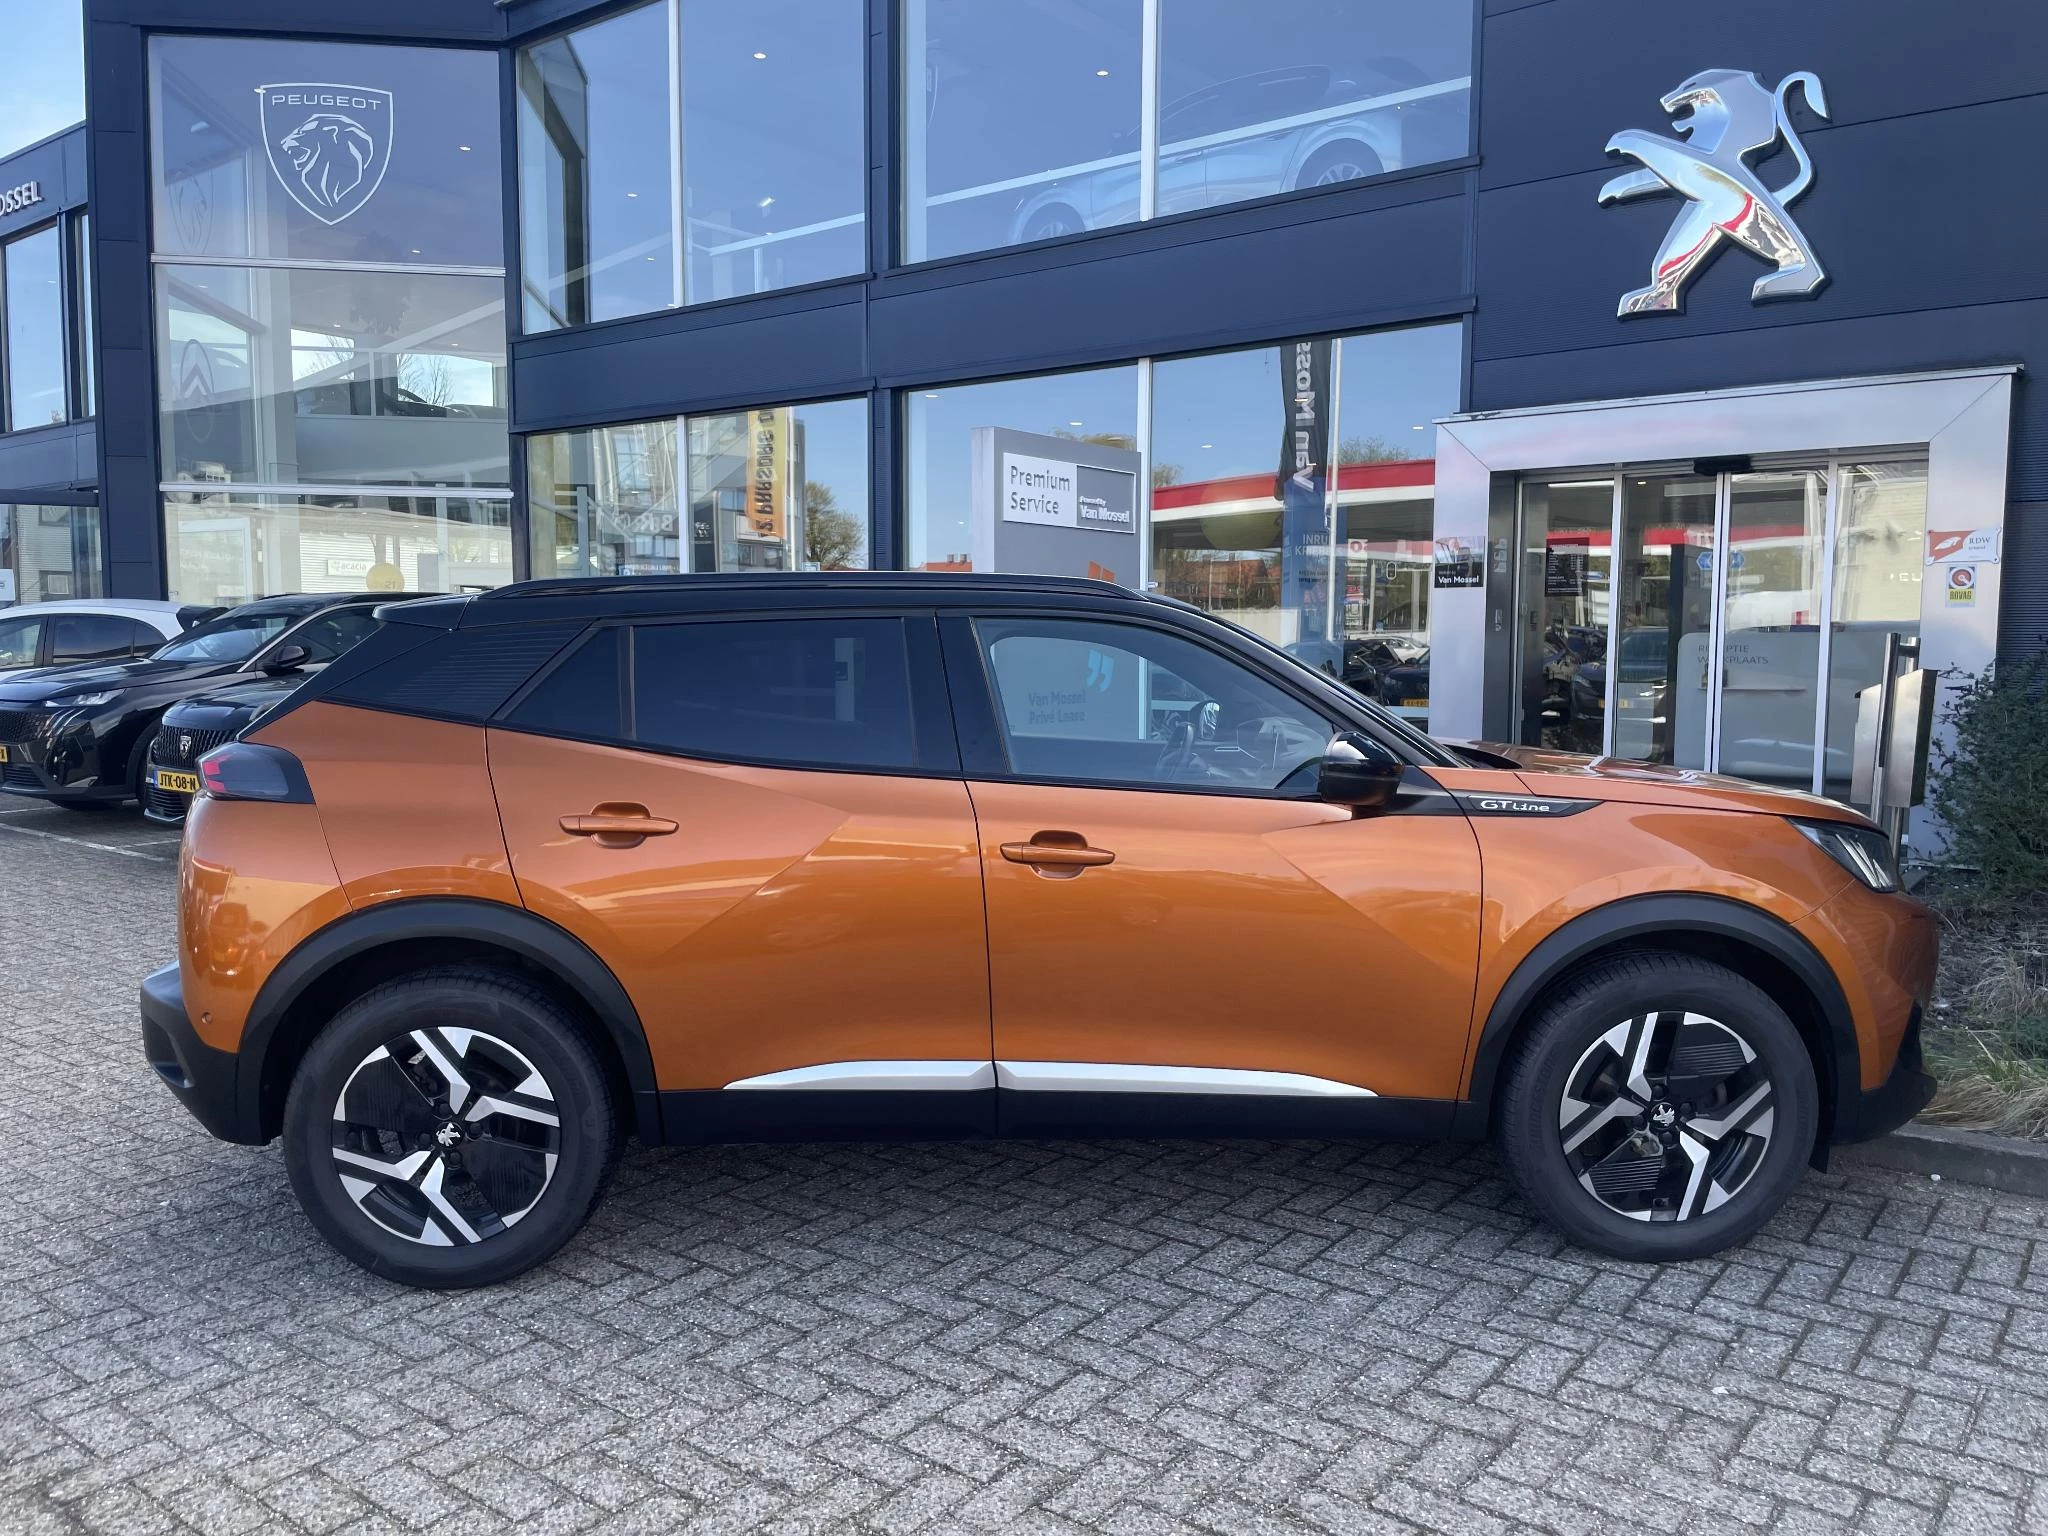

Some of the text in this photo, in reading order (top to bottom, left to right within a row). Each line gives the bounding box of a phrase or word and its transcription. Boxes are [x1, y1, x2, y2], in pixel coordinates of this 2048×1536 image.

[271, 94, 381, 111] PEUGEOT
[1010, 465, 1070, 491] Premium
[1010, 491, 1059, 514] Service
[1080, 505, 1130, 523] Van Mossel
[1302, 533, 1334, 545] INRUI
[341, 562, 367, 571] acacia
[1438, 574, 1480, 584] Van Mossel
[1949, 590, 1972, 600] BOVAG
[1698, 644, 1750, 653] RPTIE
[1697, 655, 1769, 665] WKPLAATS
[1028, 688, 1087, 707] Van Mossel
[1057, 709, 1086, 723] Lease
